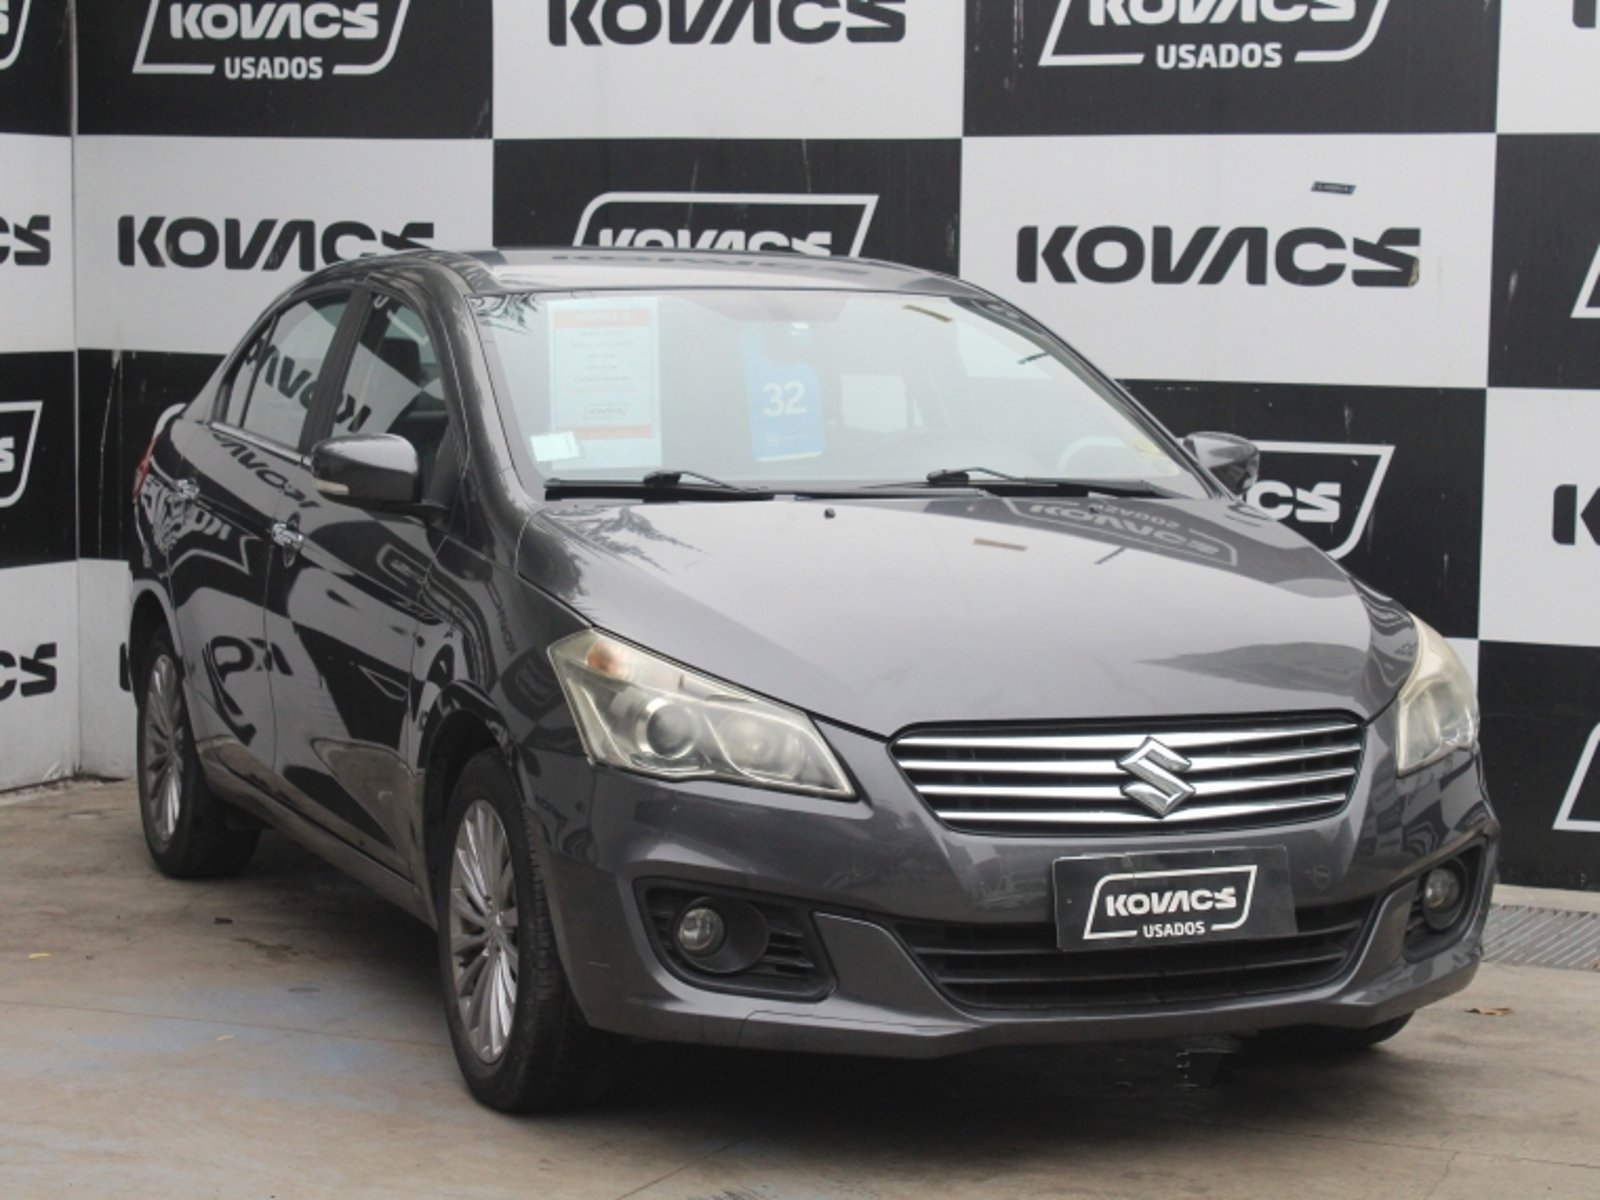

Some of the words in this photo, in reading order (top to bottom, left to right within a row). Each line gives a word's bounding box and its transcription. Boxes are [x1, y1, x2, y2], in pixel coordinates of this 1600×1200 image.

[169, 2, 380, 40] KOVACS
[548, 0, 906, 47] KOVACS
[224, 56, 323, 80] USADOS
[1155, 42, 1283, 70] USADOS
[1016, 225, 1421, 288] KOVACS
[762, 380, 808, 417] 32
[1105, 886, 1237, 917] KOVACS
[1143, 921, 1206, 938] USADOS
